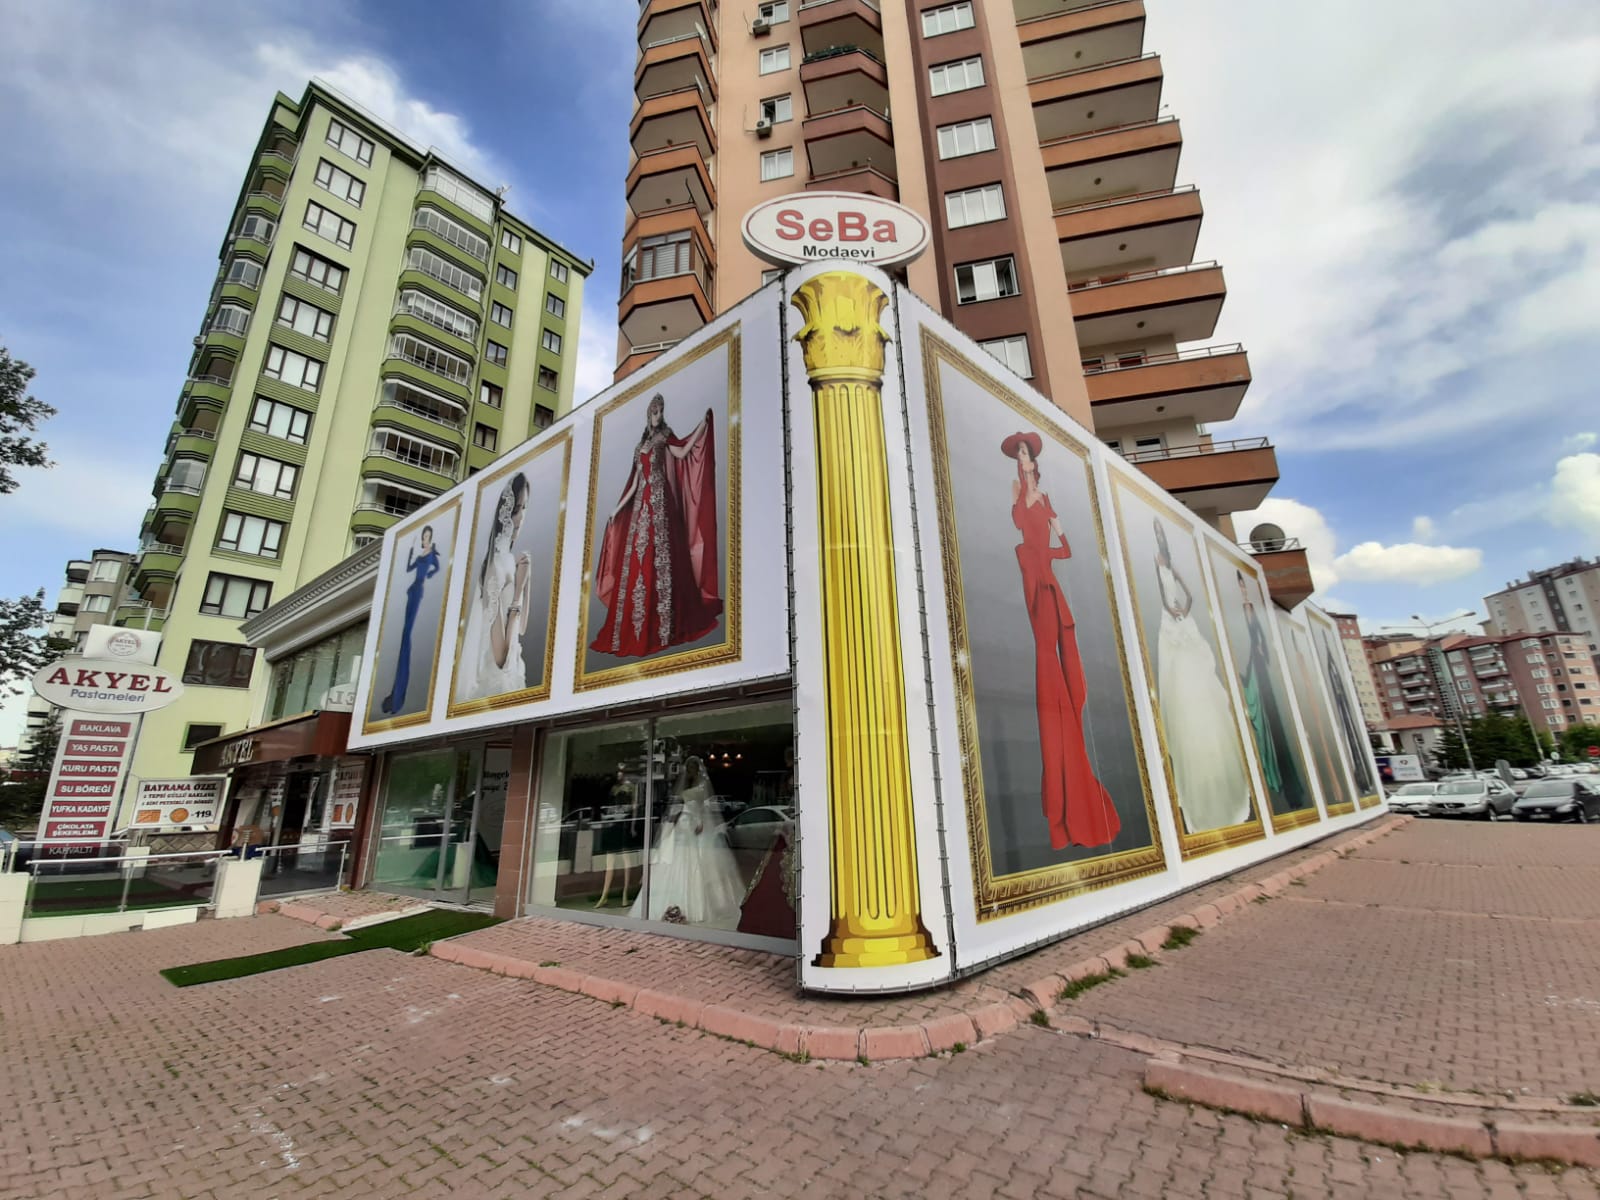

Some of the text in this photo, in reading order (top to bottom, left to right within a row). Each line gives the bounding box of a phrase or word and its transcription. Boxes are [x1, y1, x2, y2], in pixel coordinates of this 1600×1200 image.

[775, 209, 898, 243] SeBa
[802, 245, 875, 258] Modaevi
[46, 667, 172, 693] AKYEL
[70, 688, 145, 702] Pastaneleri
[79, 724, 122, 733] BAKLAVA
[72, 743, 119, 752] YAŞ PASTA
[61, 764, 118, 773] KURU PASTA
[60, 784, 112, 793] SU BÖREĞİ
[144, 782, 217, 792] BAYRAMA ÖZEL
[52, 805, 111, 813] YUFKA KADAYIF
